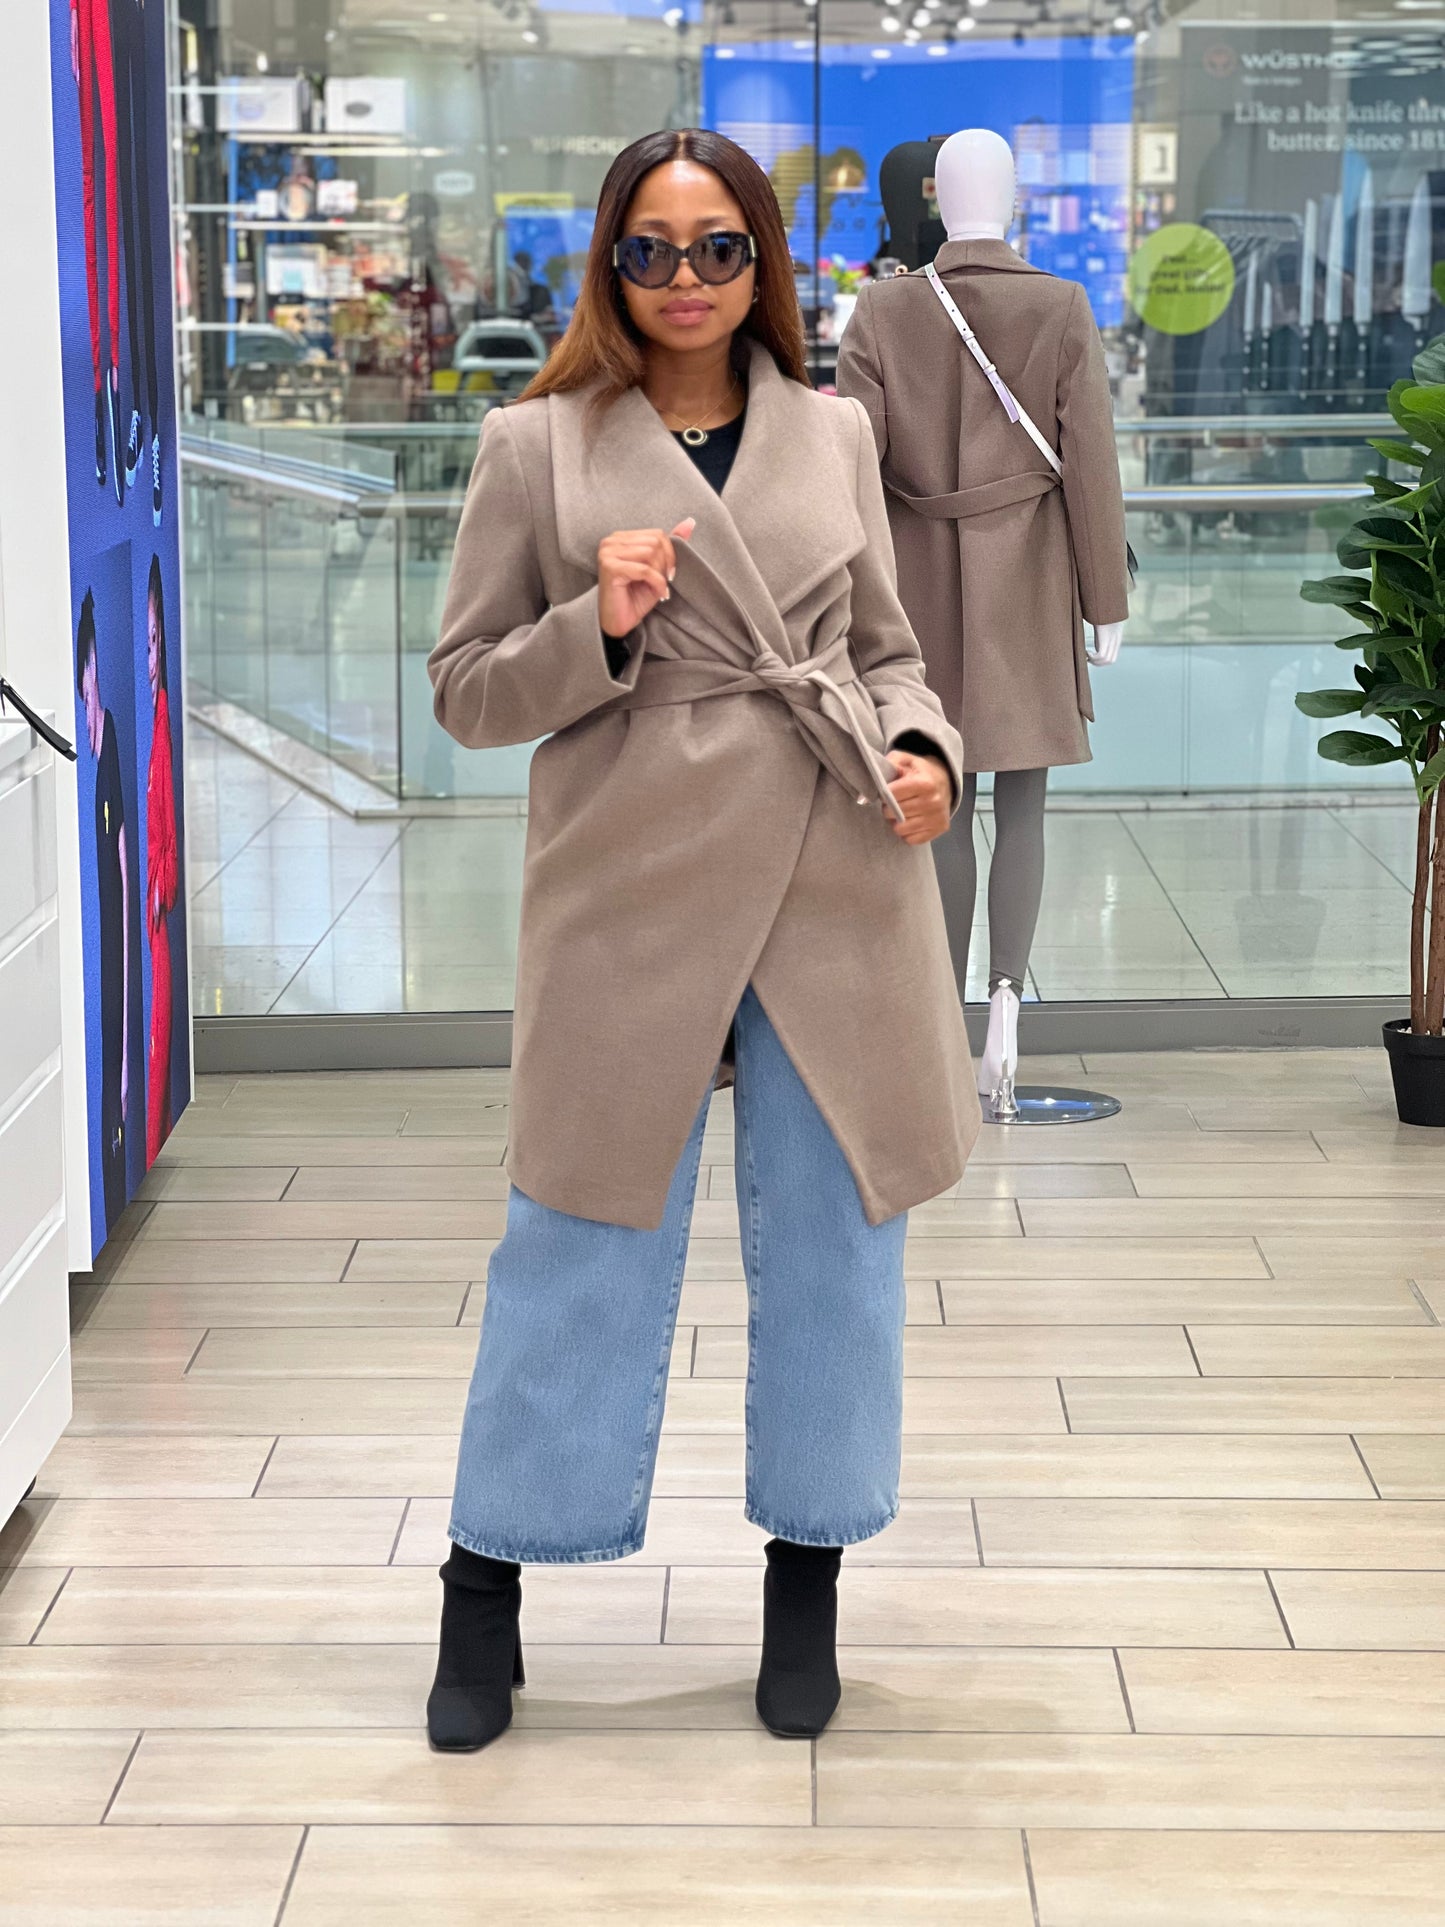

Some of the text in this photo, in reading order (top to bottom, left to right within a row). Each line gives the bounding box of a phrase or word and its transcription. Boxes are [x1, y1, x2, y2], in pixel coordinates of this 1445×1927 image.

[1235, 101, 1282, 123] Like
[1286, 106, 1300, 123] a
[1305, 101, 1341, 123] hot
[1347, 101, 1404, 123] knife
[1345, 128, 1404, 151] since
